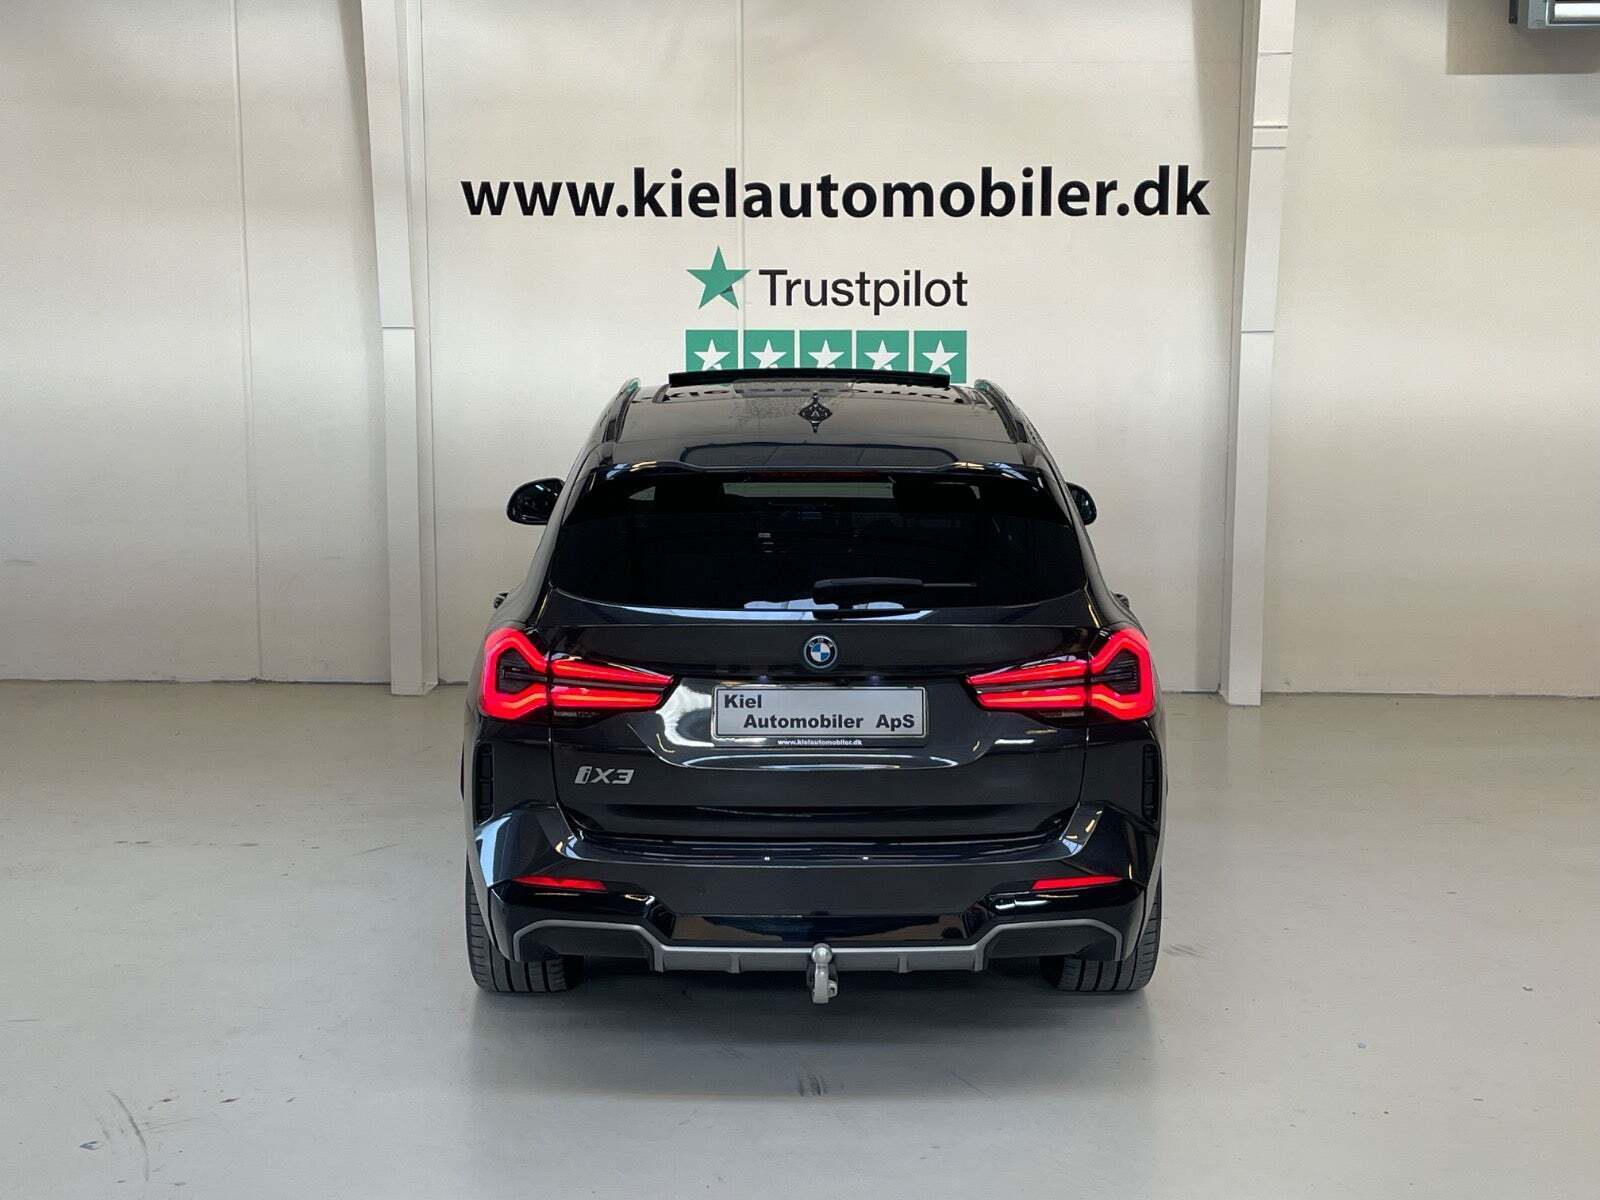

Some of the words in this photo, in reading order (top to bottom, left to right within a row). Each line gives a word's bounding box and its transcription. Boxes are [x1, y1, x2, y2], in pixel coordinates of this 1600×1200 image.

[461, 164, 1211, 219] www.kielautomobiler.dk
[758, 269, 968, 316] Trustpilot
[724, 694, 762, 709] Kiel
[743, 714, 864, 729] Automobiler
[875, 714, 915, 732] ApS
